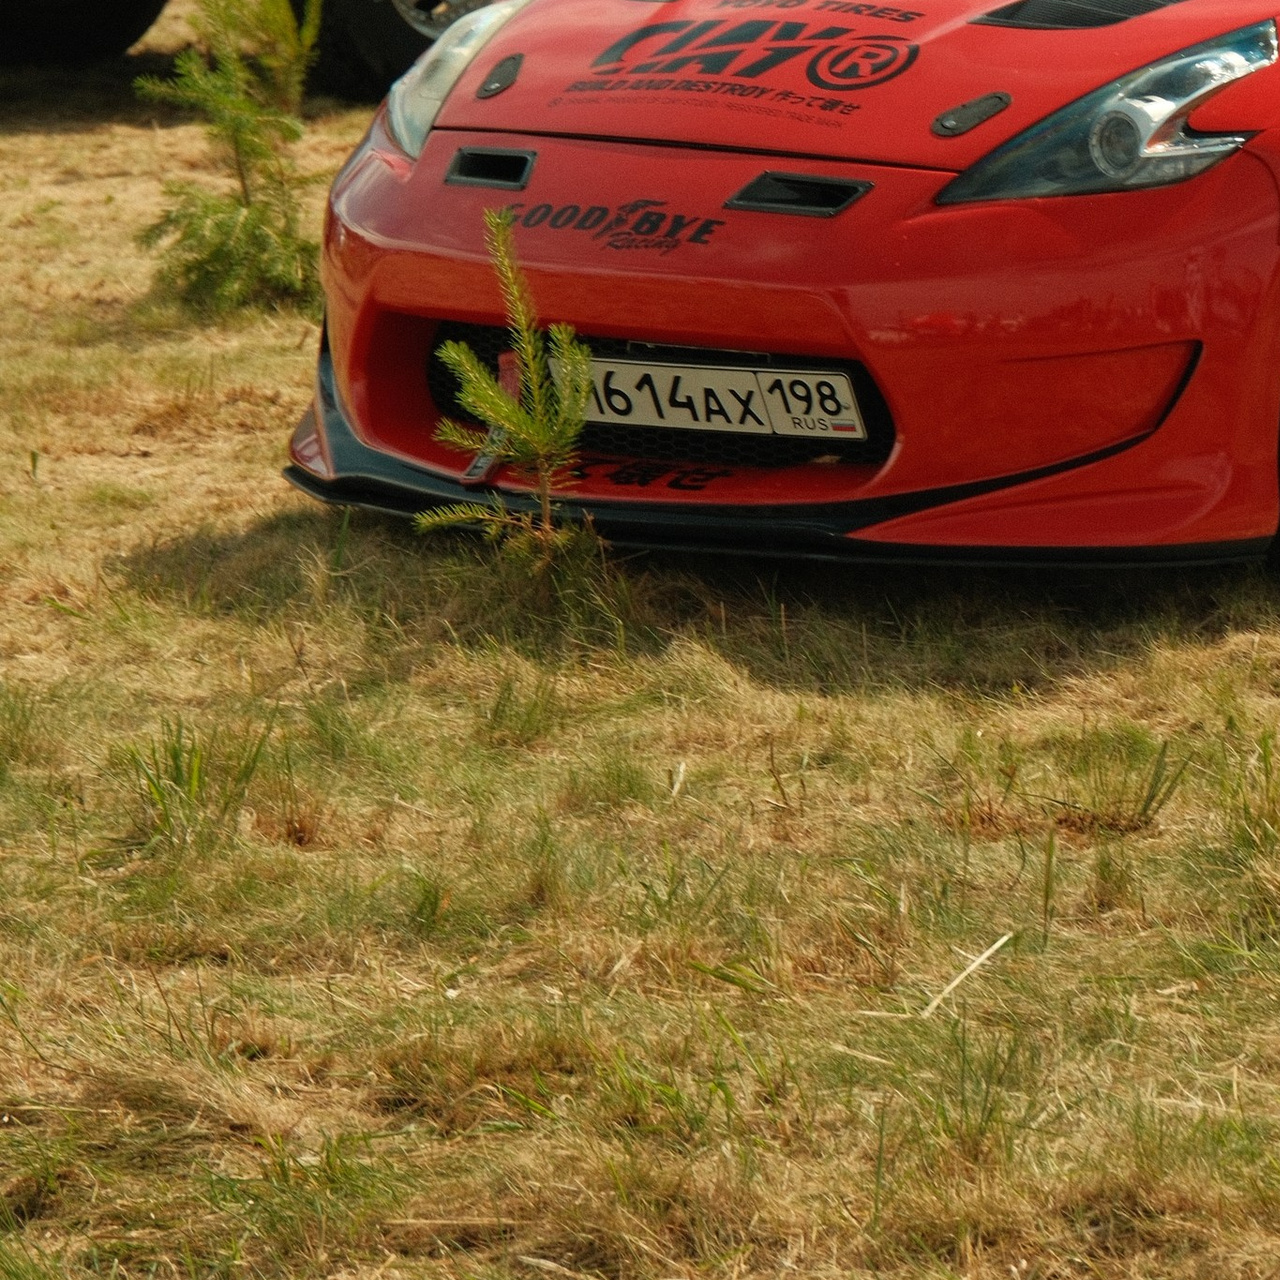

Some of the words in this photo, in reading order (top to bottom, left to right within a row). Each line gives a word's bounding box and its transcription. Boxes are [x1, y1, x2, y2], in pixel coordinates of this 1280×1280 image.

[814, 0, 925, 22] TIRES
[626, 79, 677, 93] AND
[677, 80, 772, 98] DESTROY
[767, 378, 843, 417] 198
[793, 416, 830, 432] RUS
